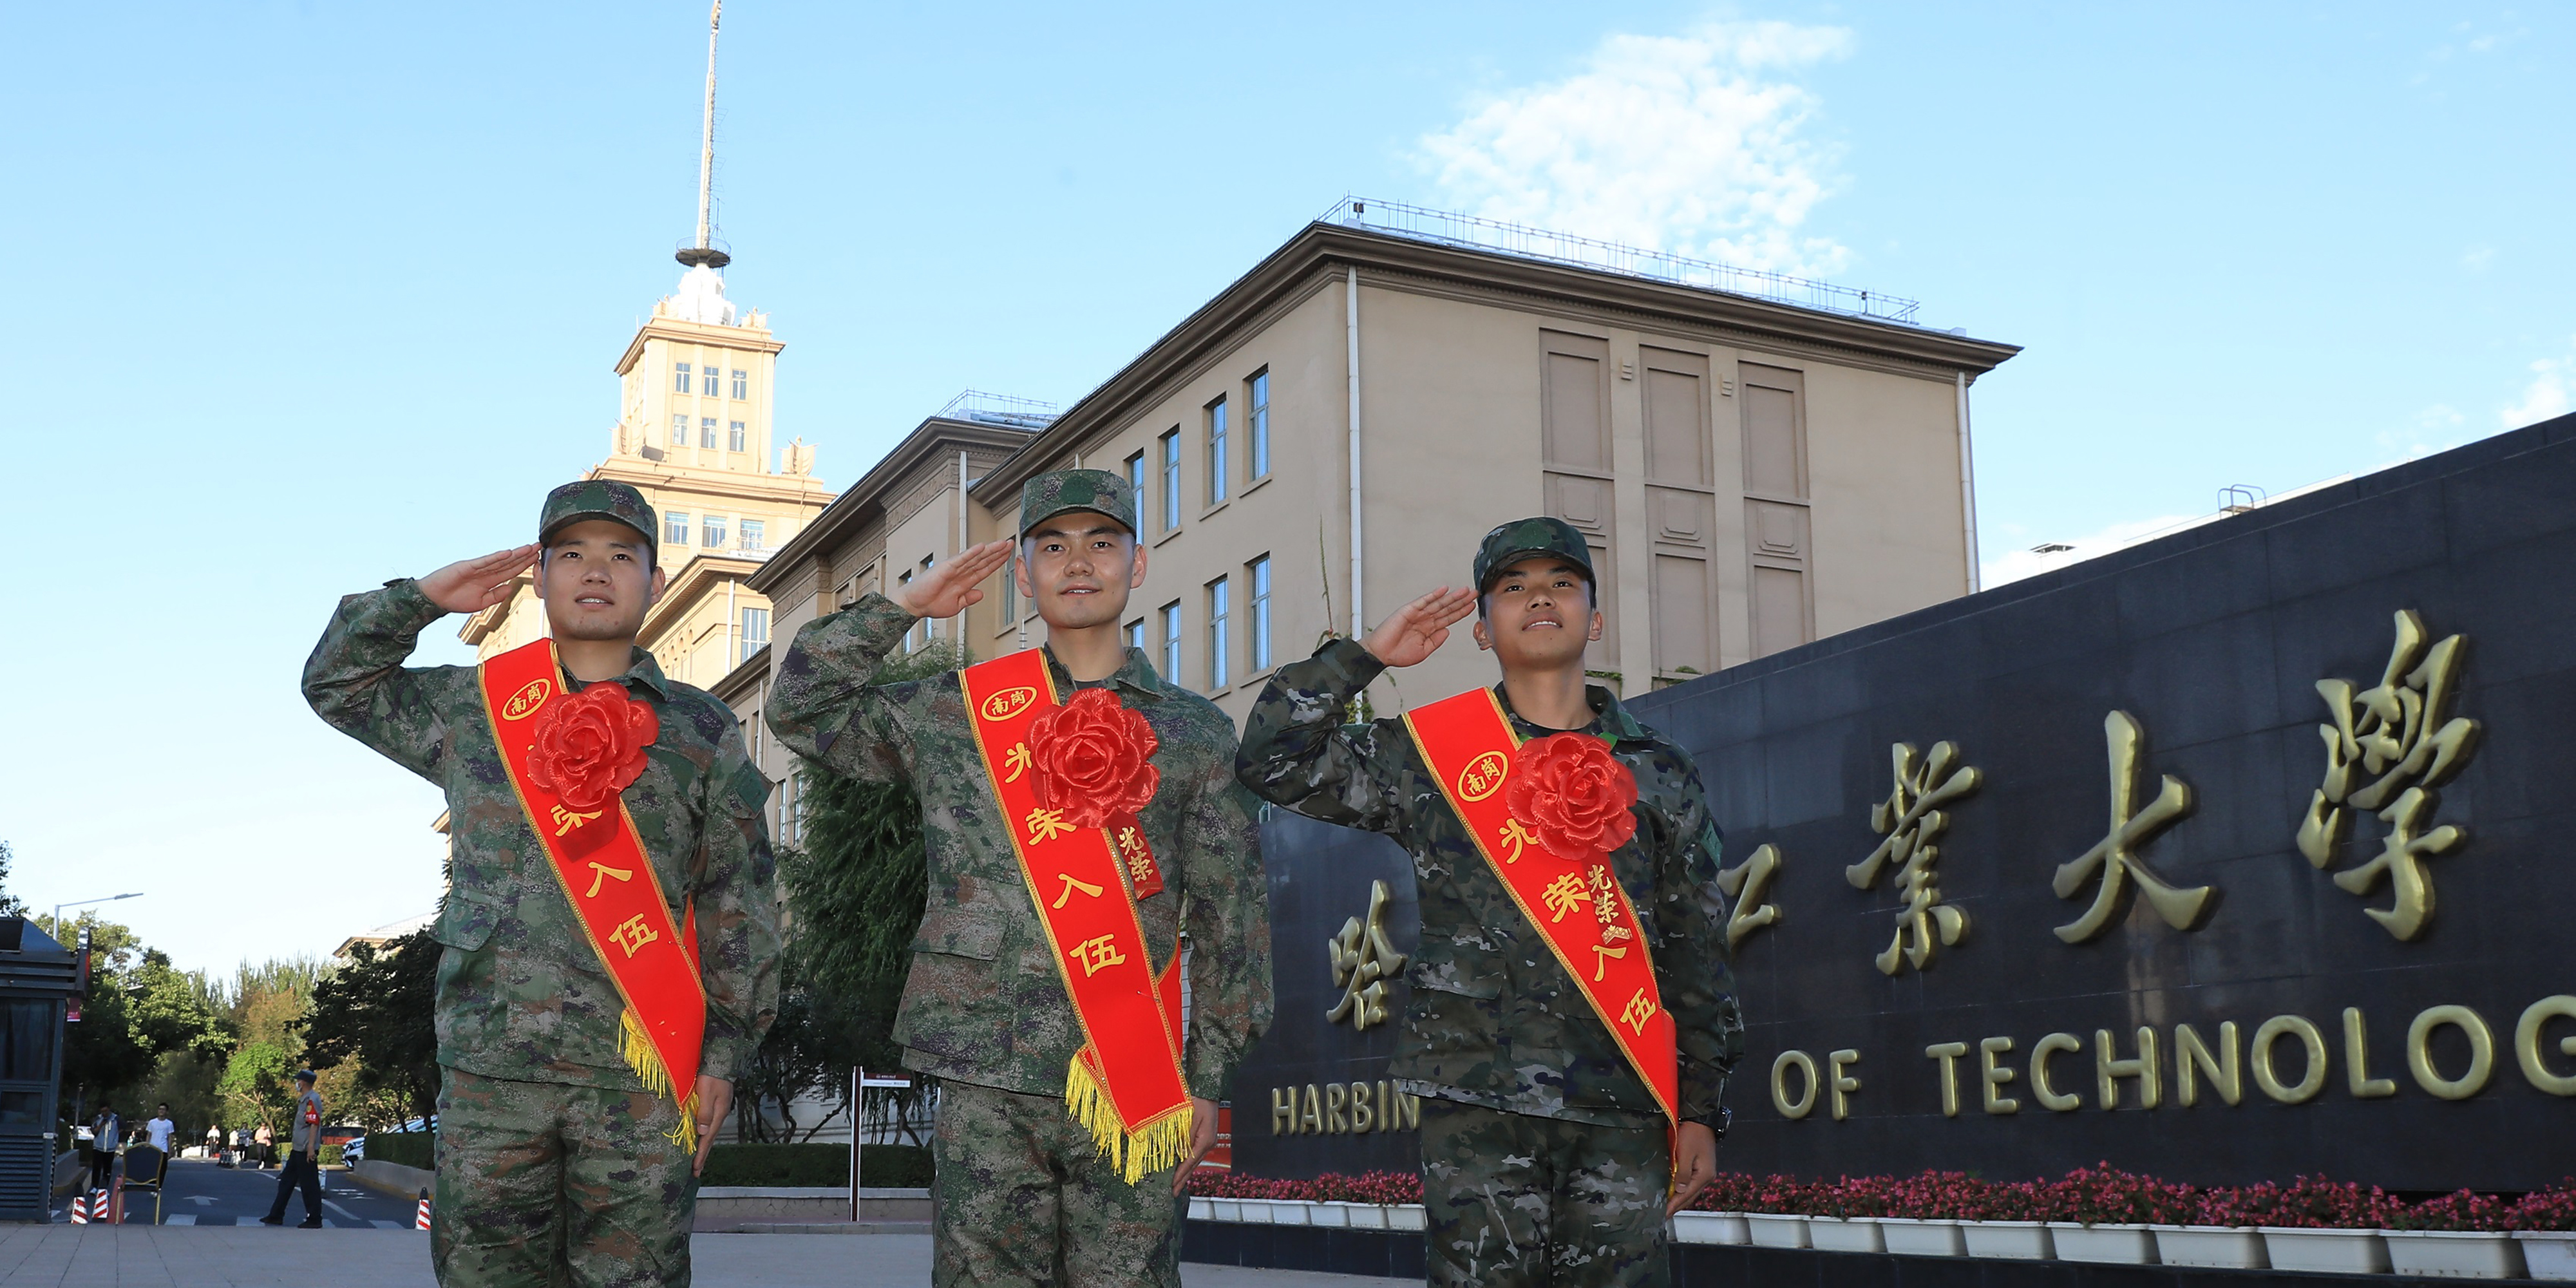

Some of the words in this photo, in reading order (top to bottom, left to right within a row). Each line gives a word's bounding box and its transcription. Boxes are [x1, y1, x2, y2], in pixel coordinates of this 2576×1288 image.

[511, 683, 542, 715] 南岗
[991, 690, 1027, 715] 南岗
[1466, 757, 1501, 795] 南岗
[1119, 826, 1153, 882] 光荣
[1587, 864, 1619, 923] 光荣
[1326, 879, 1408, 1031] 哈
[1272, 1078, 1420, 1135] HARBIN
[1770, 1048, 1862, 1121] OF
